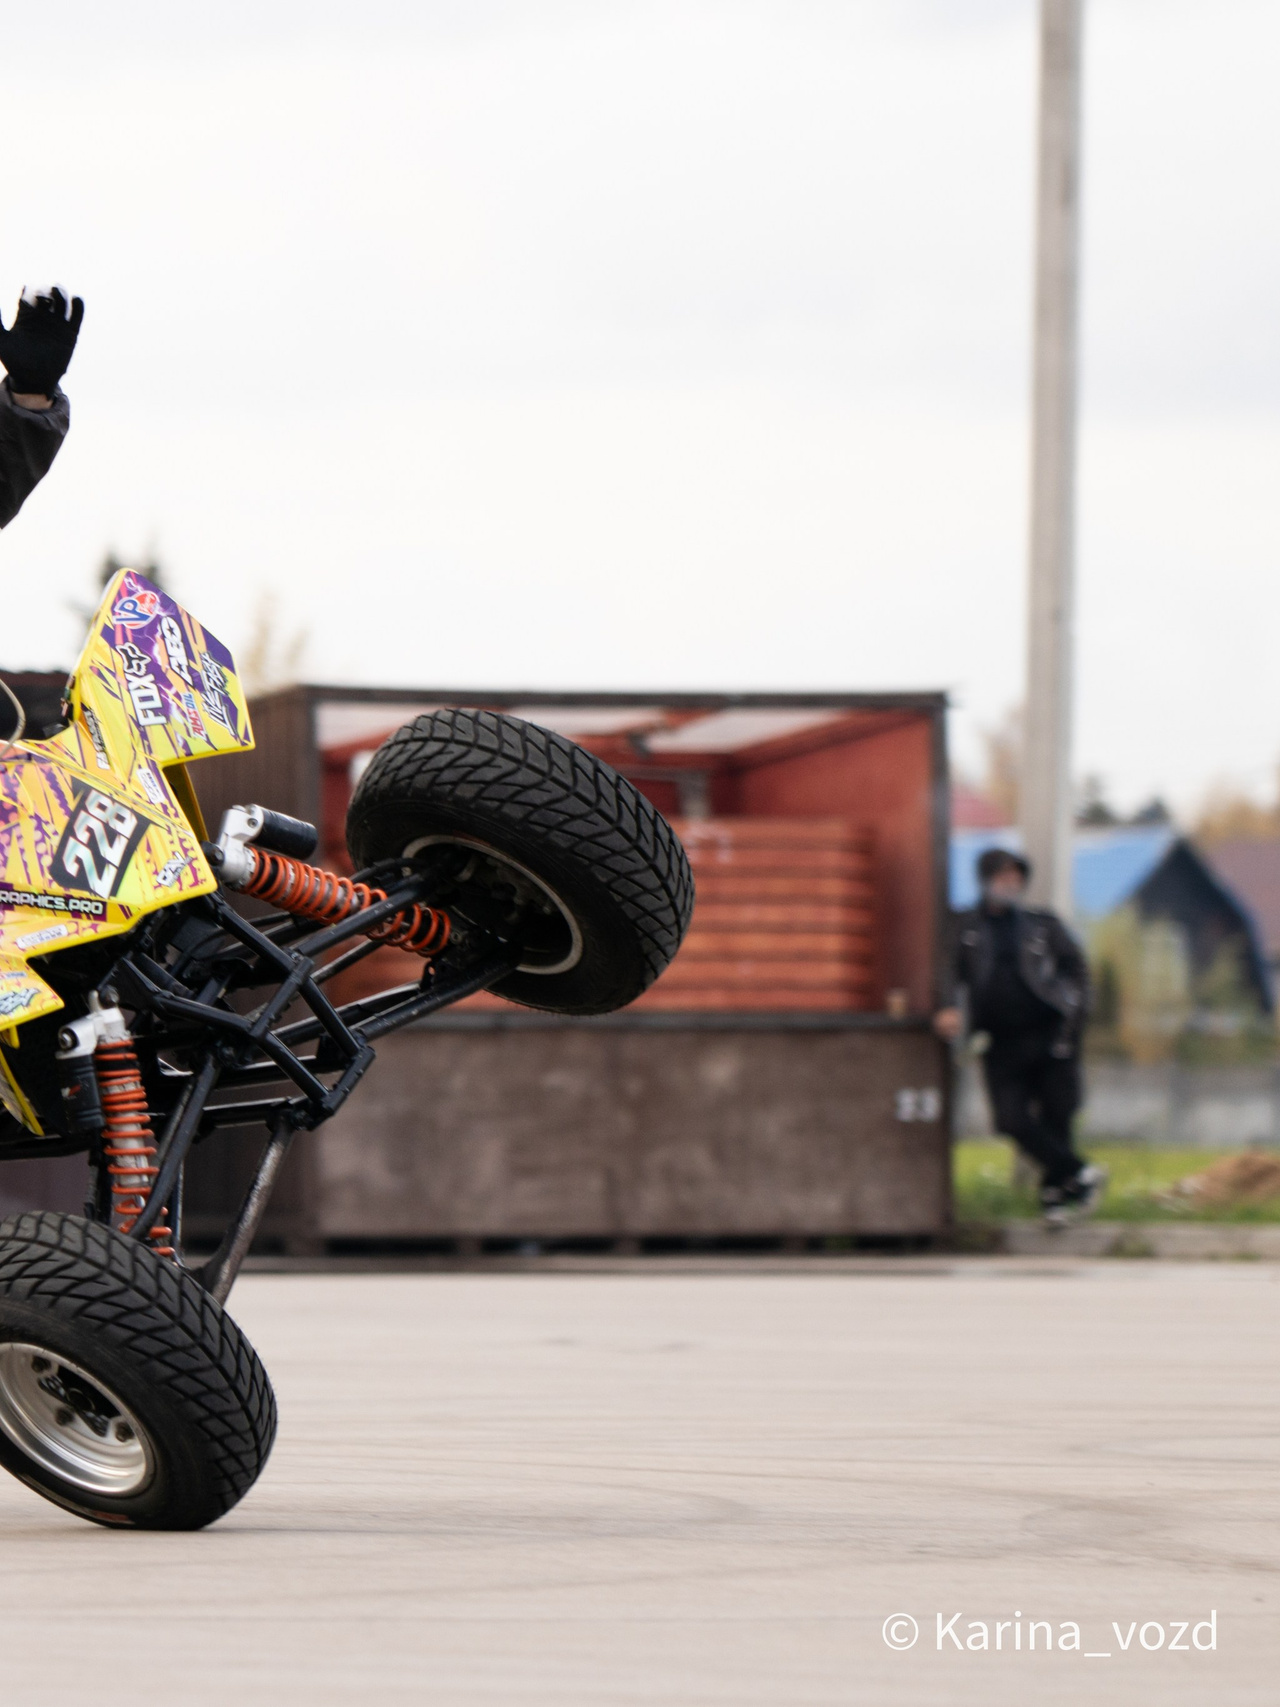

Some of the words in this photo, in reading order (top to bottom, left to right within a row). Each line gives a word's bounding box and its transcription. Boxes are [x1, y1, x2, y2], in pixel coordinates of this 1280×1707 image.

[113, 596, 153, 625] VP
[127, 673, 168, 727] FOX
[182, 692, 207, 740] AMSOIL
[62, 789, 138, 899] 228
